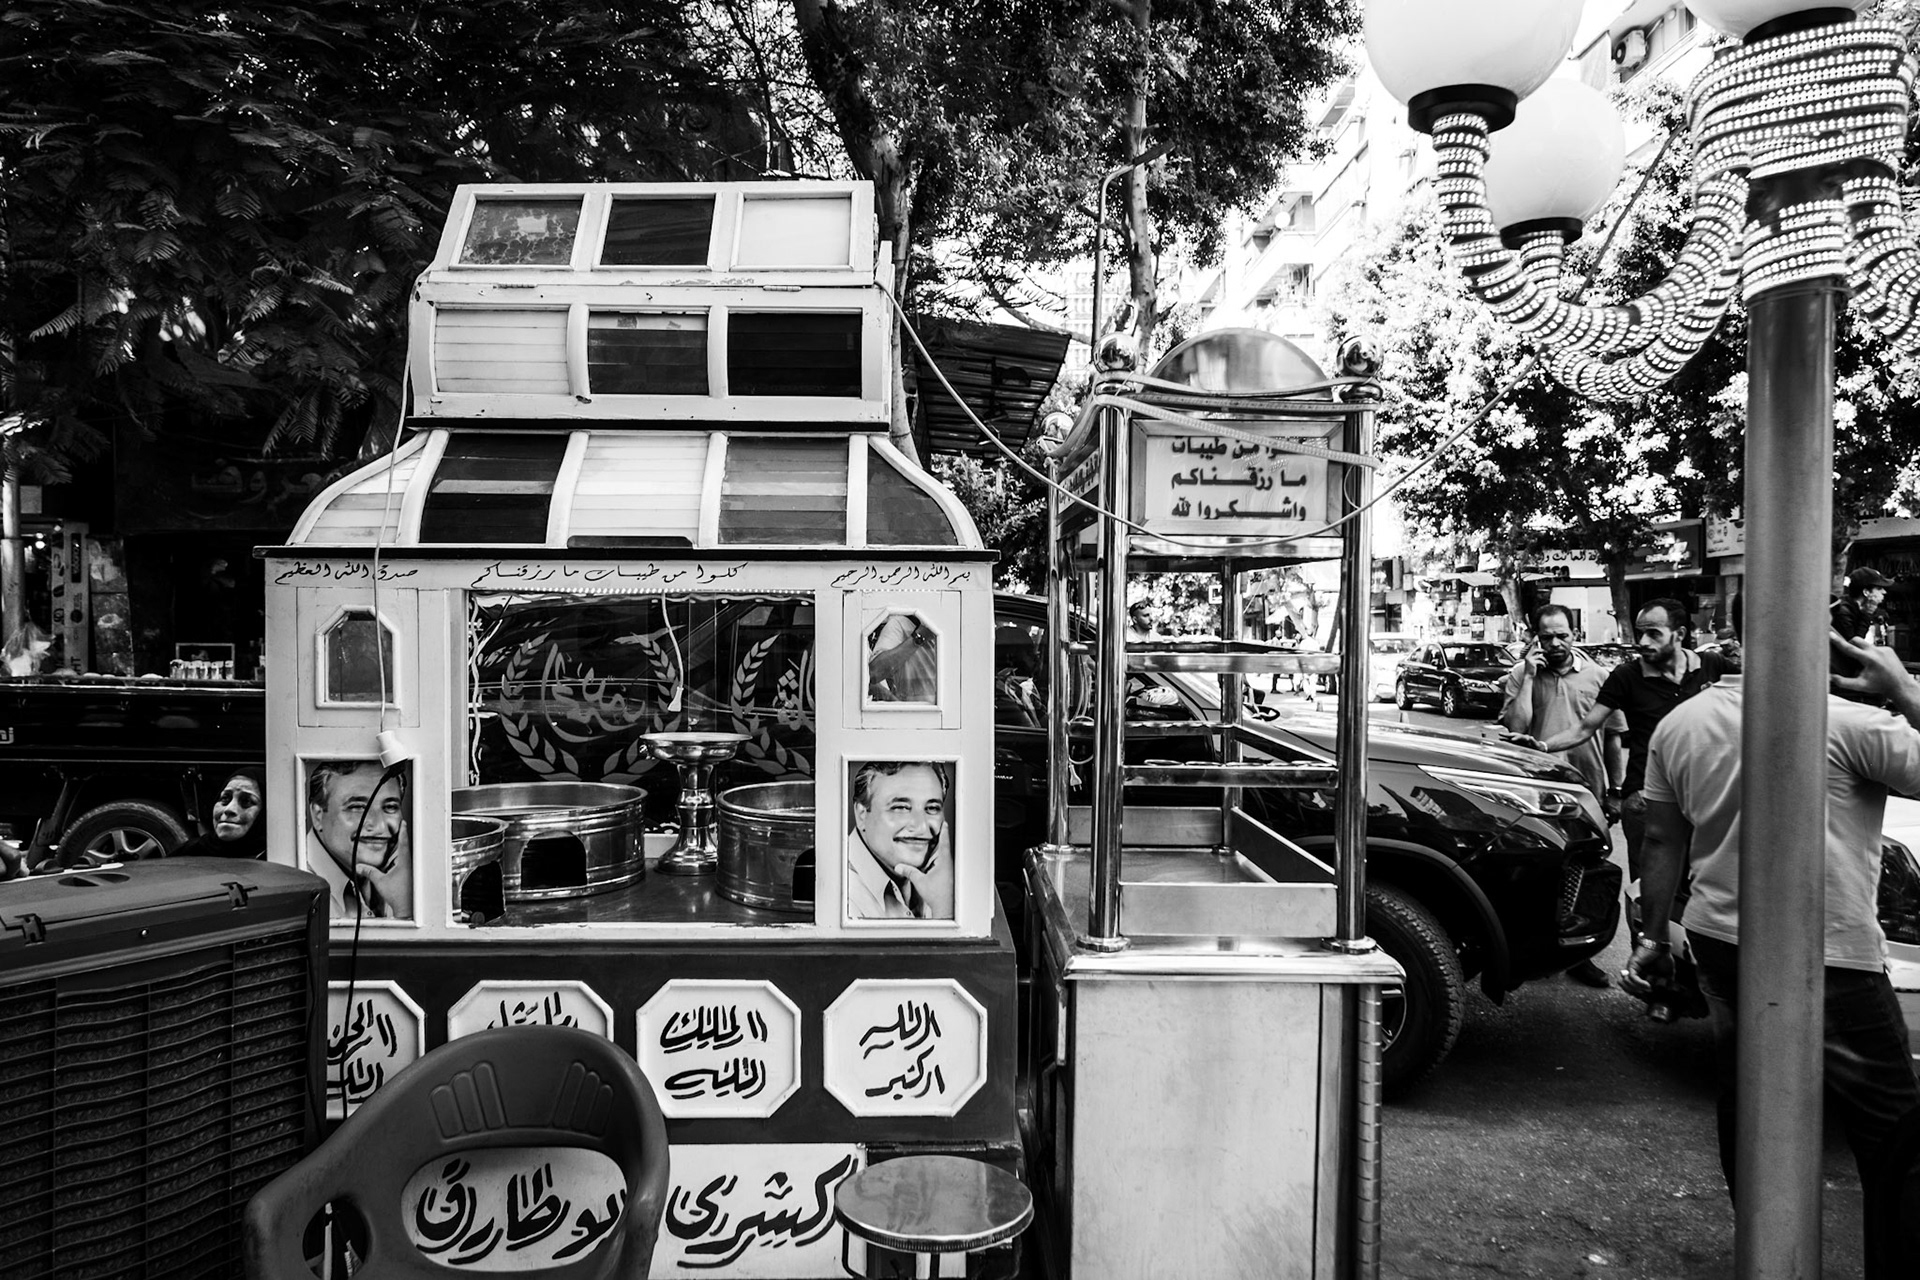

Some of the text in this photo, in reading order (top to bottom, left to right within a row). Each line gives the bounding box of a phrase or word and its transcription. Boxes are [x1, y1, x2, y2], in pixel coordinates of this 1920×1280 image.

[1171, 436, 1227, 460] طيبات
[1171, 466, 1307, 491] ما رزقناكم
[1198, 496, 1307, 521] واشكروا
[274, 561, 418, 585] صدق الله العظيم
[470, 561, 749, 589] كلوا من طيبات ما رزقناكم
[830, 563, 971, 589] بسم الله الرحمن الرحيم
[659, 1004, 768, 1055] الملك
[858, 1000, 943, 1060] الله
[414, 1157, 572, 1265] طارق
